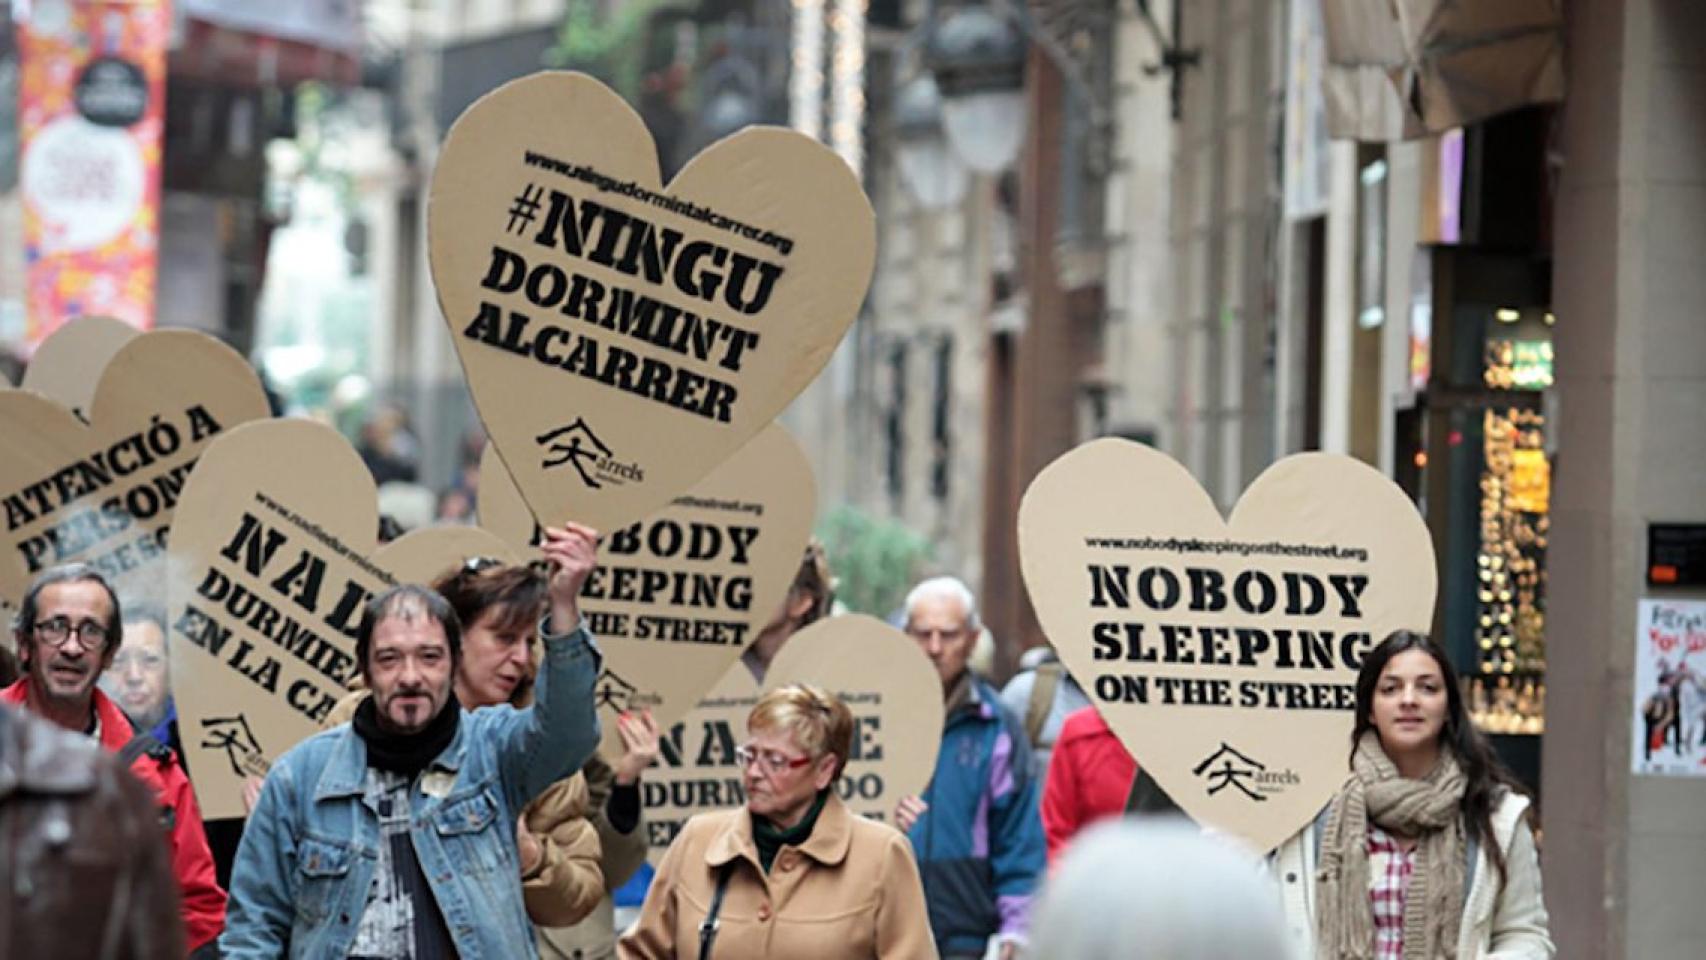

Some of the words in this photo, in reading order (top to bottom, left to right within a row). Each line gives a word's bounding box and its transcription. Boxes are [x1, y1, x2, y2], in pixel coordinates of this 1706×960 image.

[506, 182, 784, 315] #NINGU
[525, 150, 794, 255] www.ningudormintalcarrer.org
[464, 302, 738, 423] ALCARRER
[481, 246, 759, 372] DORMINT
[3, 414, 181, 531] ATENCIÓ
[185, 404, 222, 442] A
[220, 511, 377, 639] NAD
[529, 519, 758, 564] BODY
[1085, 537, 1368, 562] www.nobodysleepingonthestreet.org
[1087, 564, 1369, 618] NOBODY
[174, 603, 232, 657] EN
[227, 638, 281, 694] LA
[286, 680, 338, 724] CA
[197, 566, 363, 688] DURMIE
[634, 615, 749, 646] STREET
[1092, 622, 1371, 671] SLEEPING
[1095, 674, 1147, 704] ON
[1156, 676, 1232, 708] THE
[1239, 681, 1357, 711] STREE
